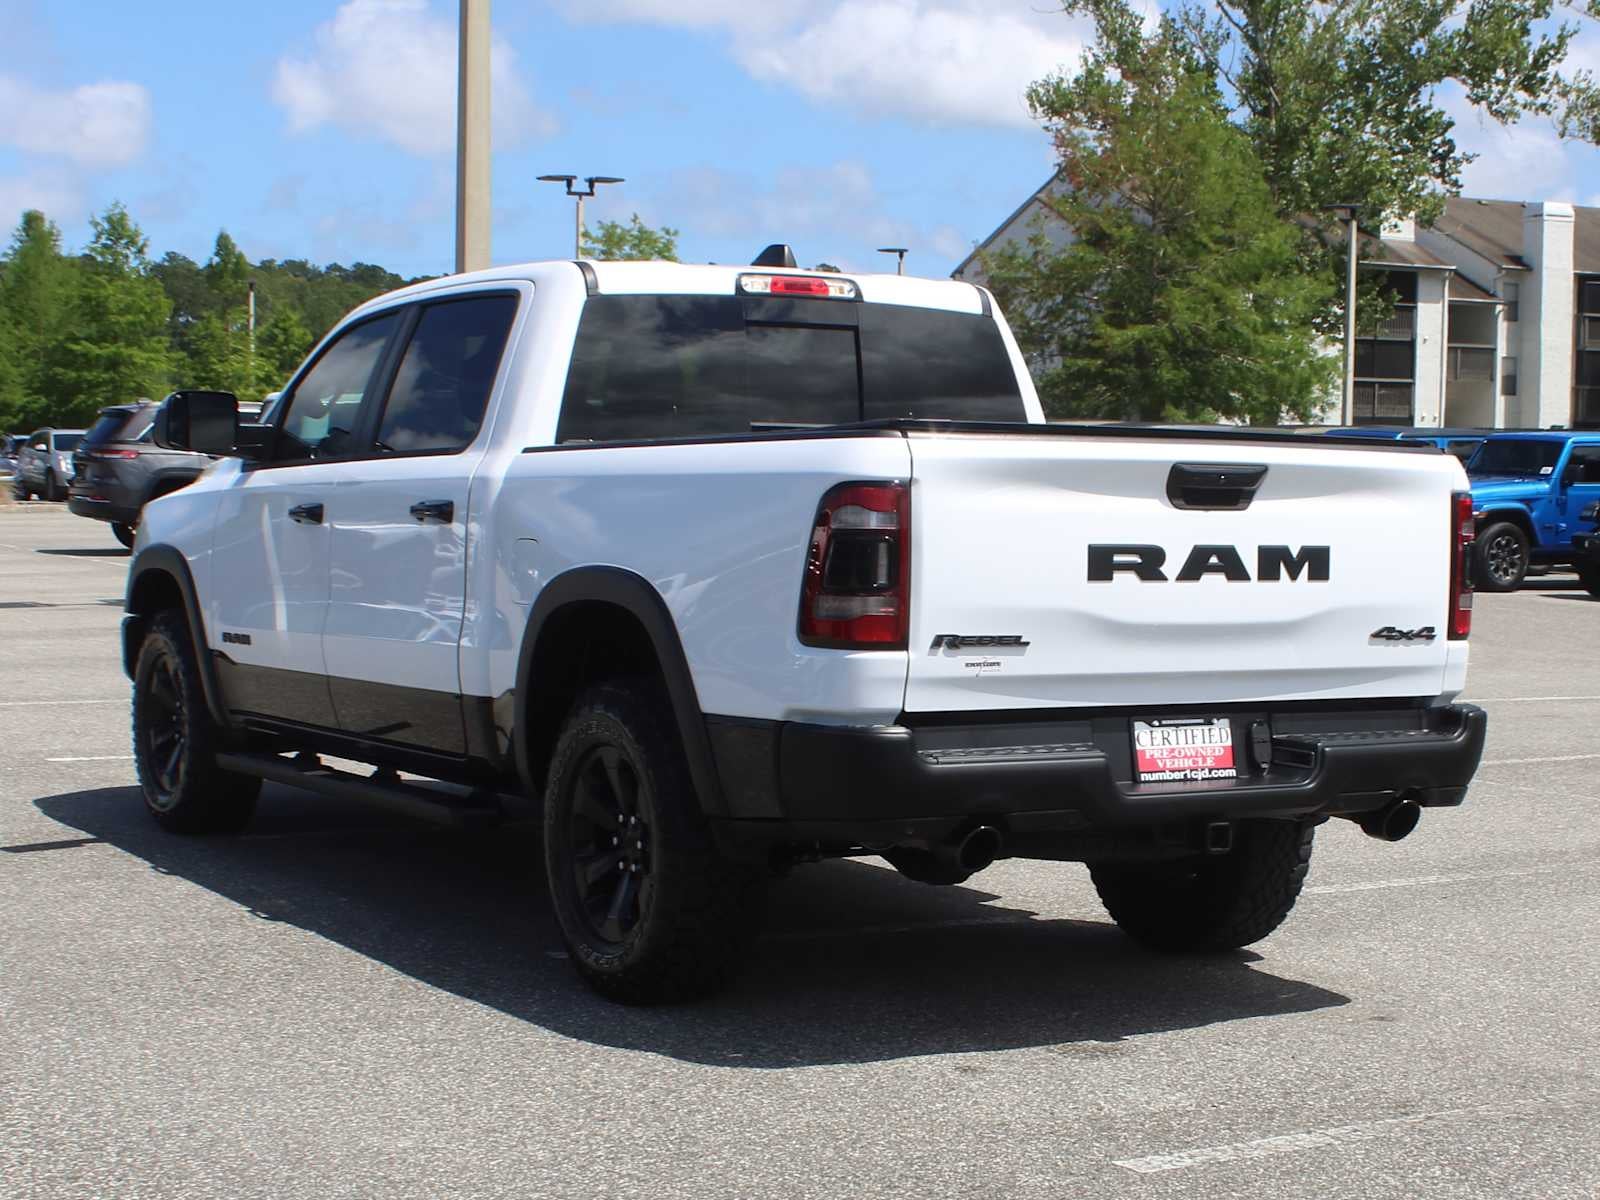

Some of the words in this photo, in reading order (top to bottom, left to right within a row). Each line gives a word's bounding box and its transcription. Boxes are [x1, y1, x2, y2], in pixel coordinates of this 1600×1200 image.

[1087, 543, 1330, 583] RAM
[1136, 727, 1229, 747] CERTIFIED
[1144, 746, 1224, 759] PRE-OWNED
[1156, 757, 1215, 769] VEHICLE
[1140, 768, 1237, 781] number1cjd.com
